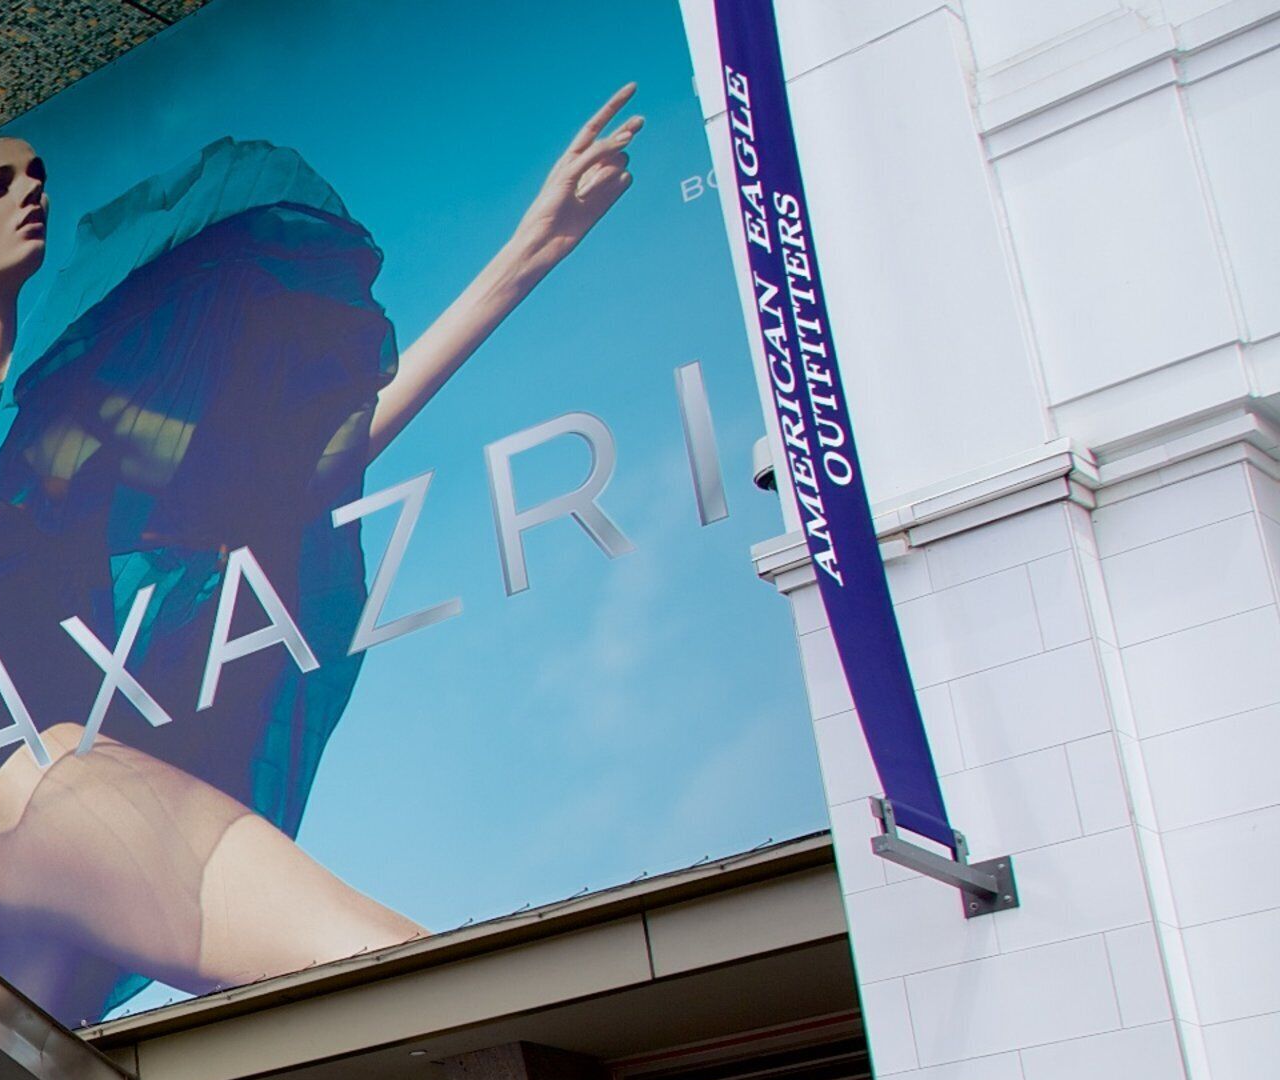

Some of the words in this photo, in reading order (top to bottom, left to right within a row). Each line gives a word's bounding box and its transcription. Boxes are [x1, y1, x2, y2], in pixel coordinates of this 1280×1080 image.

[725, 65, 772, 254] EAGLE
[754, 270, 844, 587] AMERICAN
[773, 191, 853, 486] OUTFITTERS
